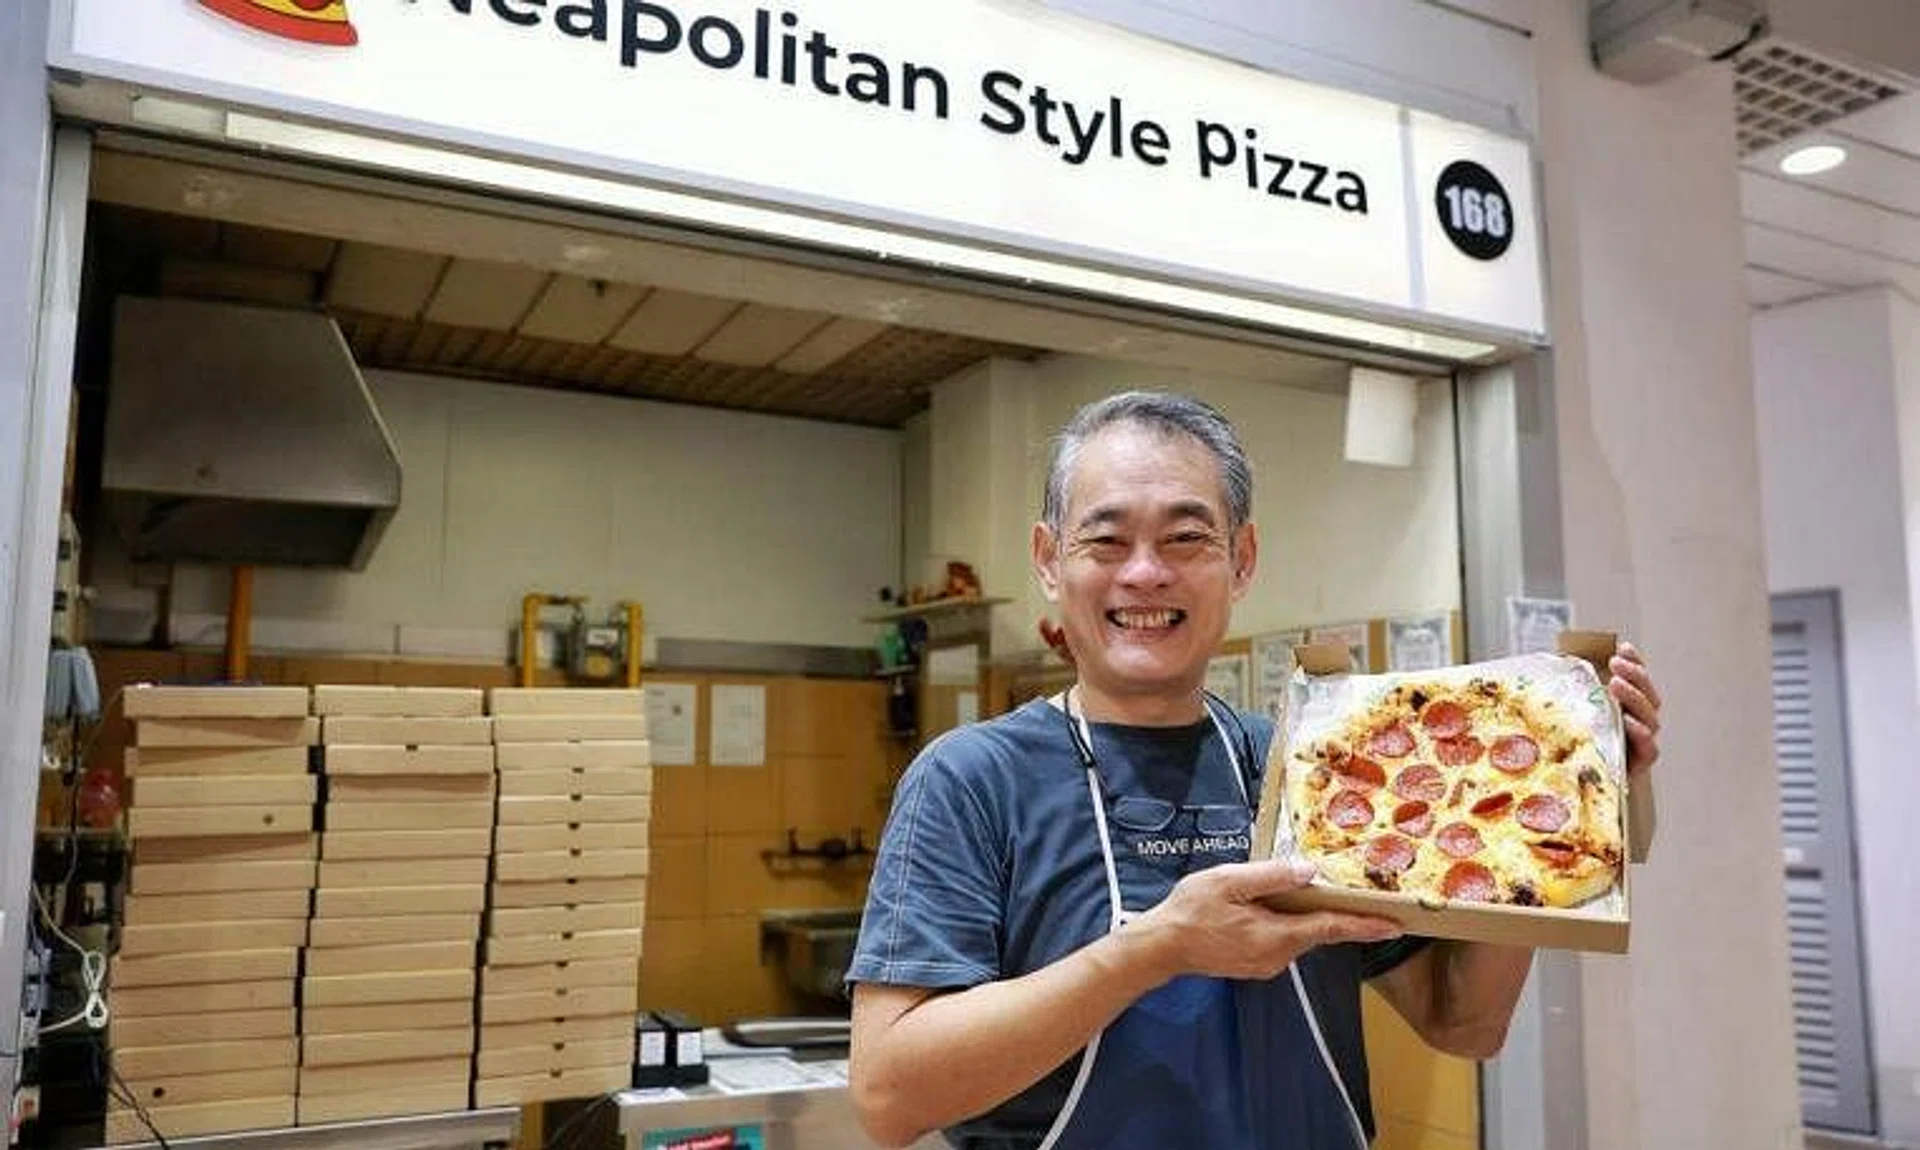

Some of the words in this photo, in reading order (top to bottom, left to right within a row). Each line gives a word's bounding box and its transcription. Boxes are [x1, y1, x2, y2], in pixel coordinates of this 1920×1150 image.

[408, 0, 949, 119] apolitan
[980, 70, 1171, 165] Style
[1444, 185, 1506, 237] 168
[1137, 838, 1189, 856] MOVE
